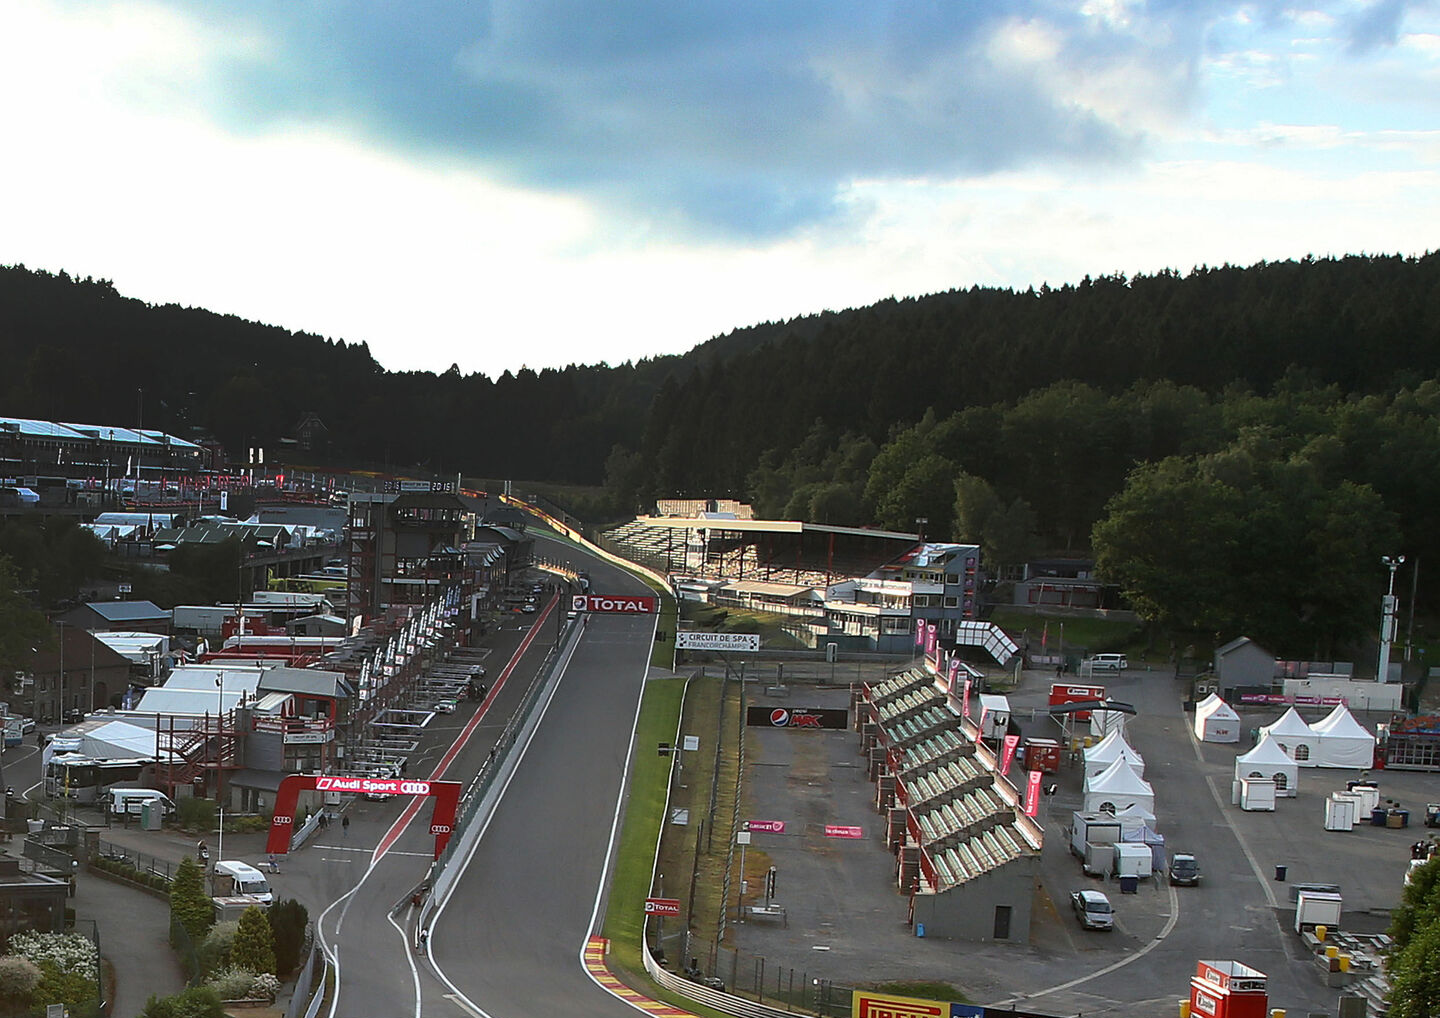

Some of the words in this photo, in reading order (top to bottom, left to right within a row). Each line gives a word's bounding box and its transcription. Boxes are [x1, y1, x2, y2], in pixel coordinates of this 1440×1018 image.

[590, 597, 649, 612] TOTAL
[688, 633, 717, 642] CIRCUIT
[719, 634, 729, 642] DE
[732, 634, 748, 643] SPA
[688, 641, 747, 650] FRANCORCHAMPS
[788, 713, 824, 728] MAX
[332, 780, 361, 790] Audi
[362, 781, 397, 792] Sport
[655, 904, 679, 912] TOTAL
